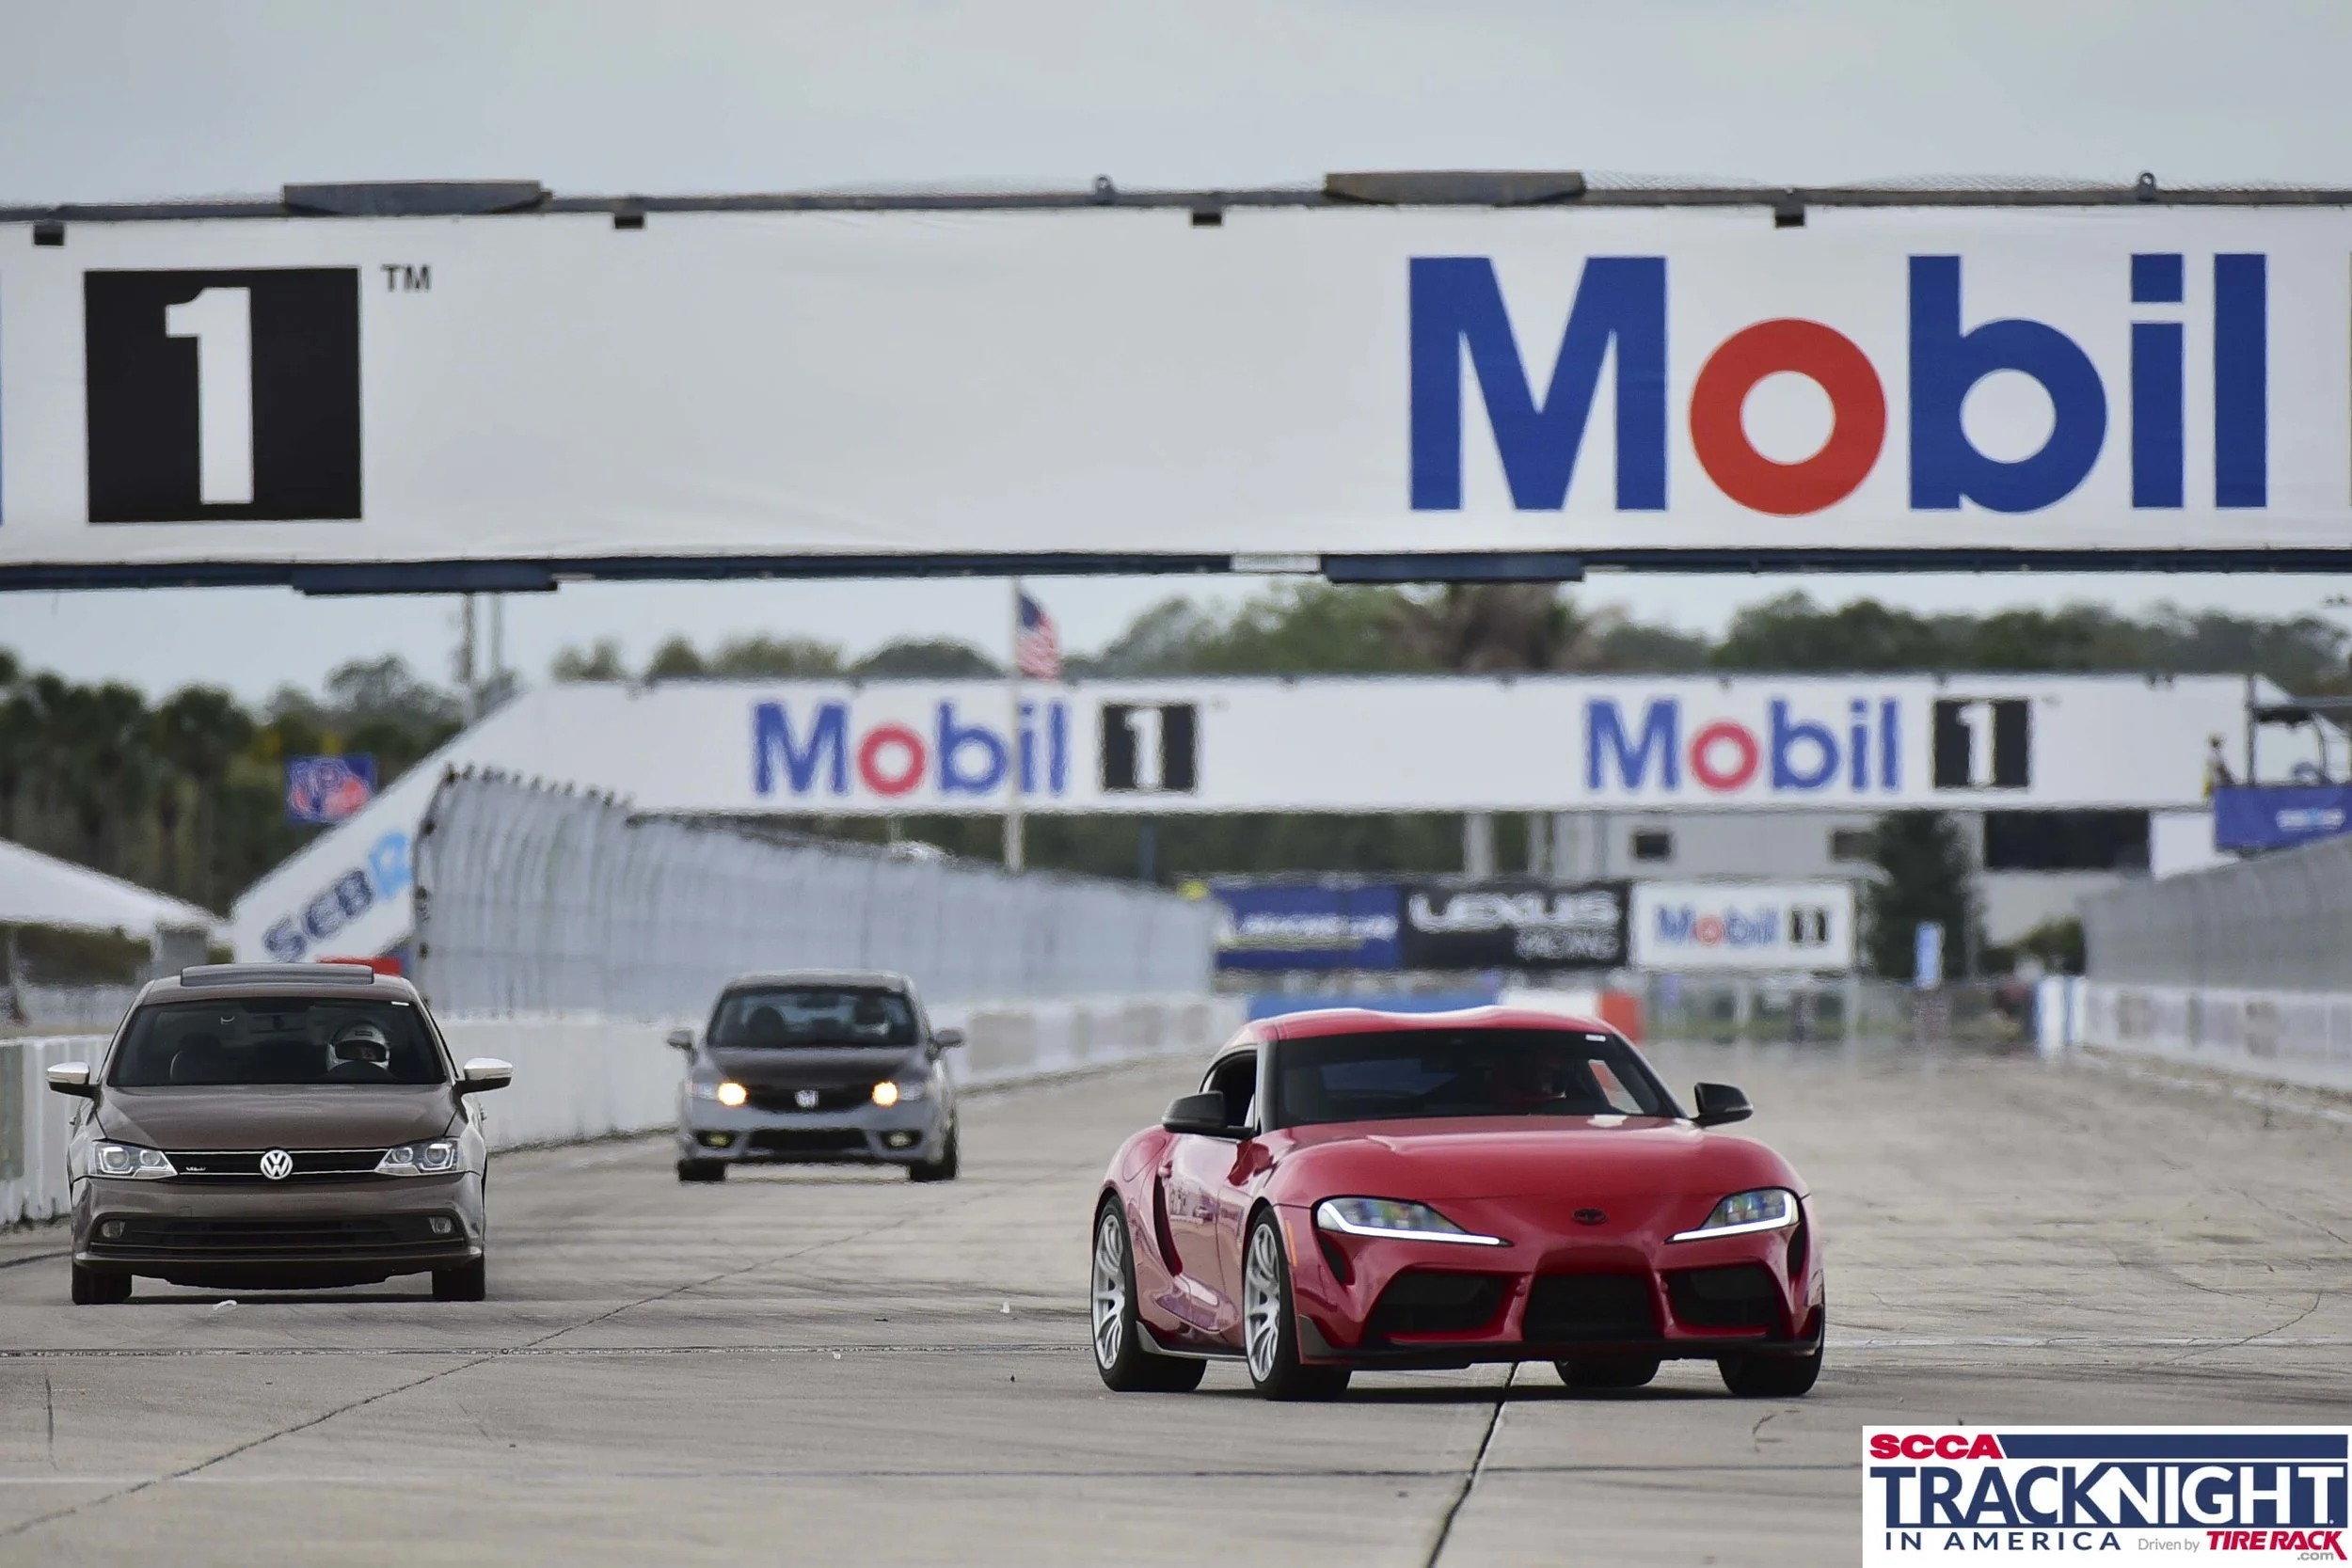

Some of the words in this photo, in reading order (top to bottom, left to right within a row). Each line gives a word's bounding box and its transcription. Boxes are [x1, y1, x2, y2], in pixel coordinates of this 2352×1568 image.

[380, 263, 432, 293] TM
[165, 286, 254, 505] 1
[1408, 252, 2267, 517] Mobil
[753, 700, 1068, 797] Mobil
[1584, 696, 1900, 792] Mobil
[1409, 891, 1620, 933] LEXUS
[1657, 904, 1780, 946] Mobil
